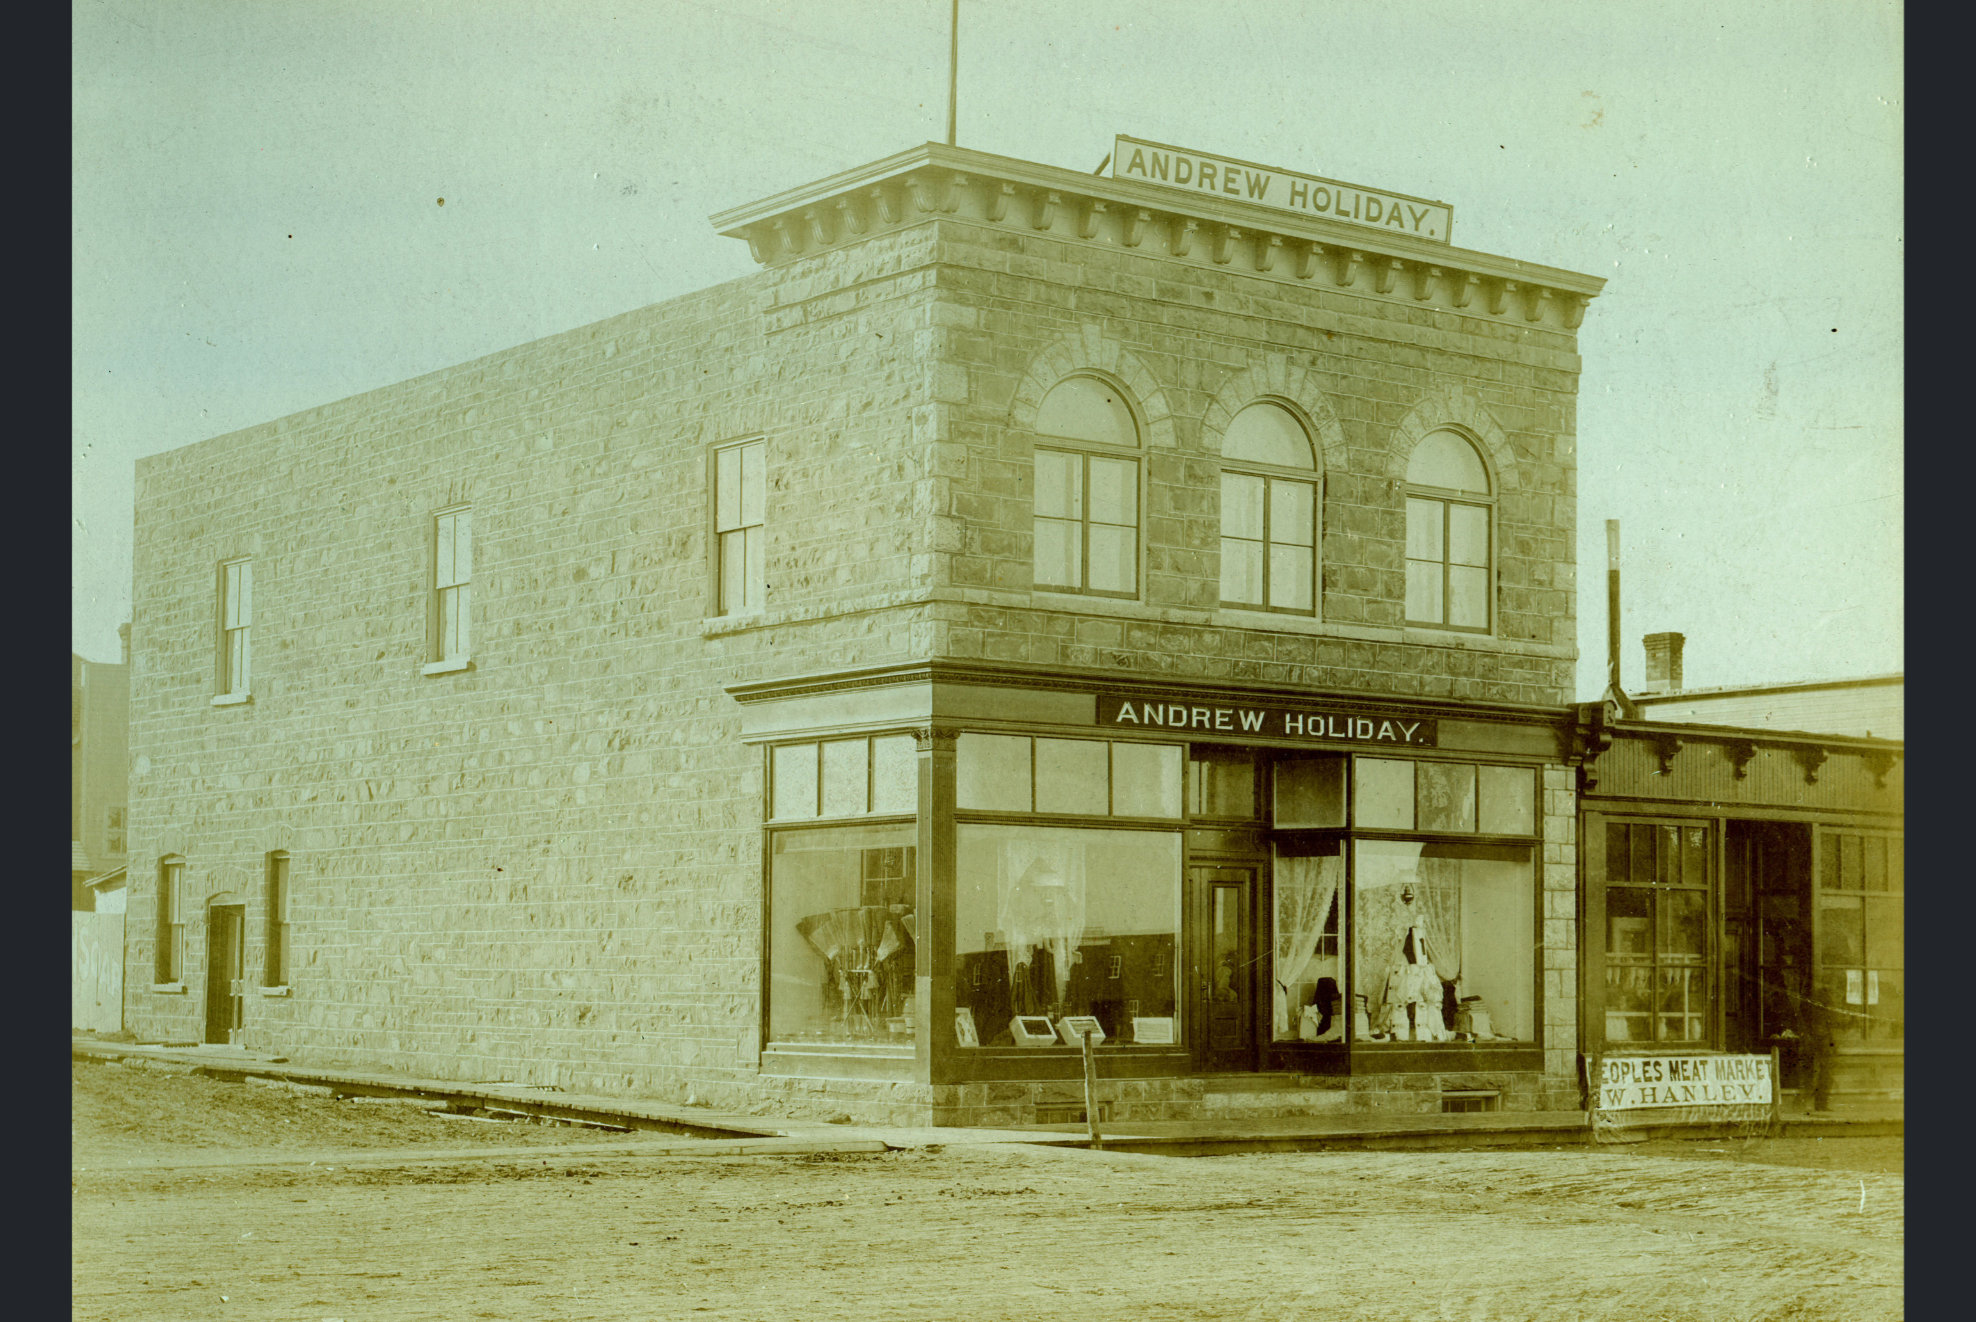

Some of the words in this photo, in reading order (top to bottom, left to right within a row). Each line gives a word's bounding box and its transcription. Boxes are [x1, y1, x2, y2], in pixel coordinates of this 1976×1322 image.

[1126, 148, 1271, 200] ANDREW
[1289, 181, 1435, 236] HOLIDAY.
[1116, 701, 1265, 732] ANDREW
[1285, 713, 1425, 743] HOLIDAY.
[1588, 1060, 1663, 1083] EOPLES
[1669, 1059, 1709, 1081] MEAT
